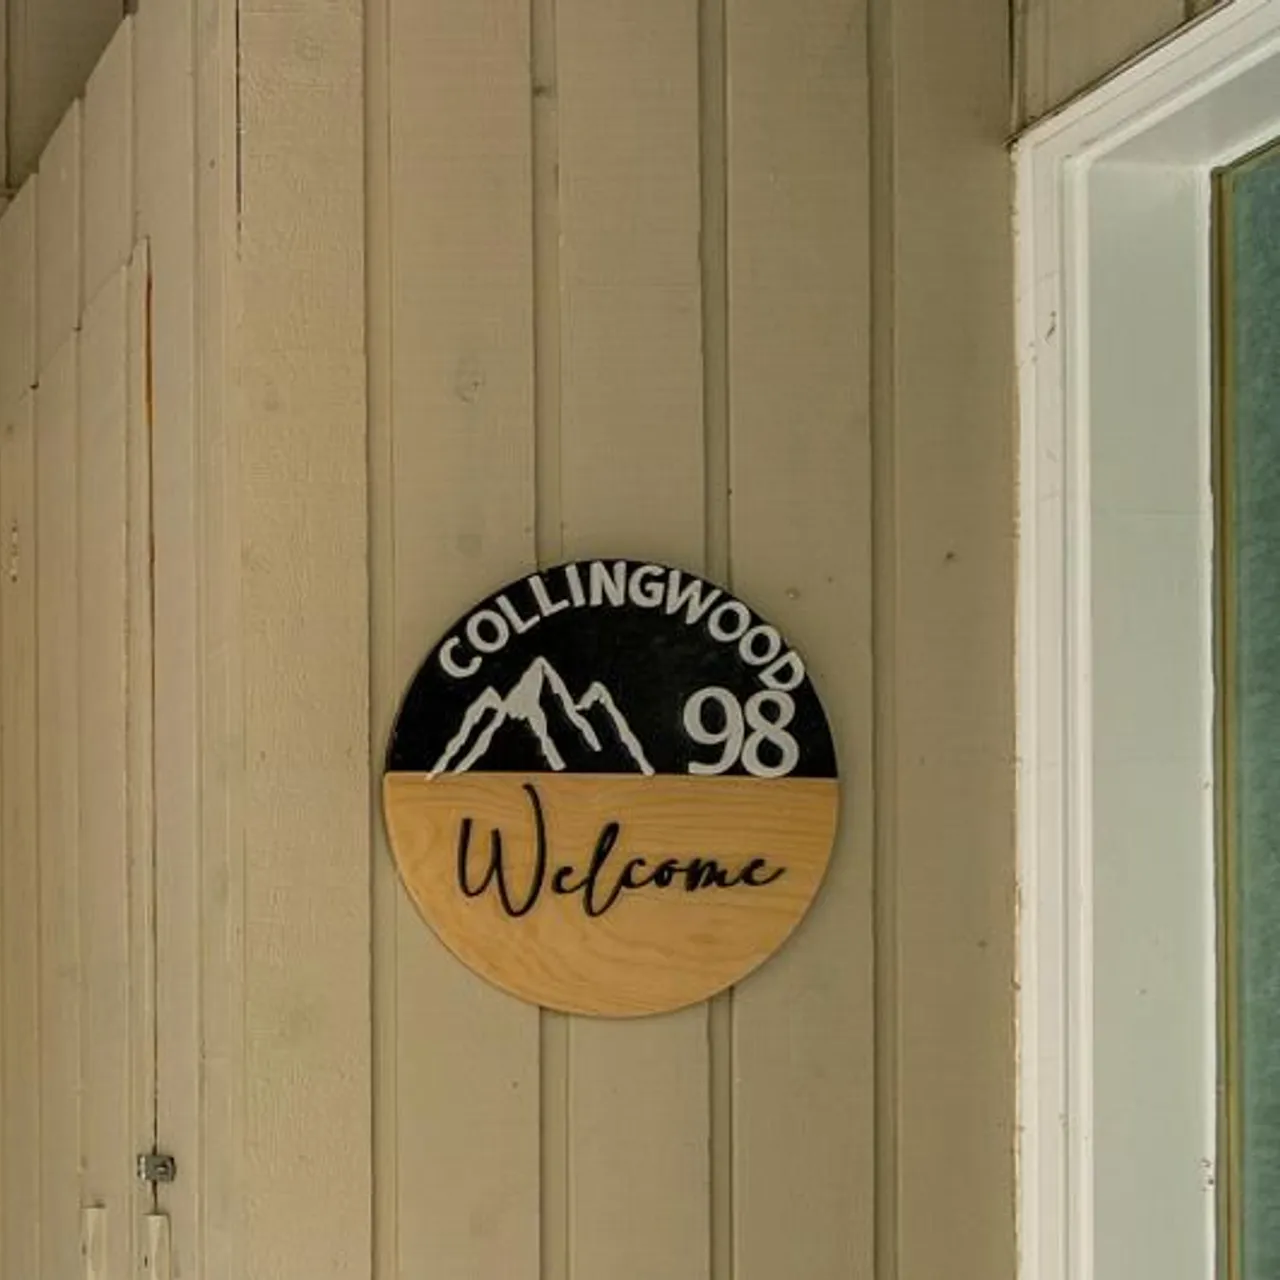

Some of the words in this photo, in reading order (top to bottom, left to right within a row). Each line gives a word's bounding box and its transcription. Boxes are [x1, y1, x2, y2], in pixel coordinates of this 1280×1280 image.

[438, 560, 806, 692] COLLINGWOOD
[682, 686, 801, 778] 98
[457, 783, 787, 918] Welcome
